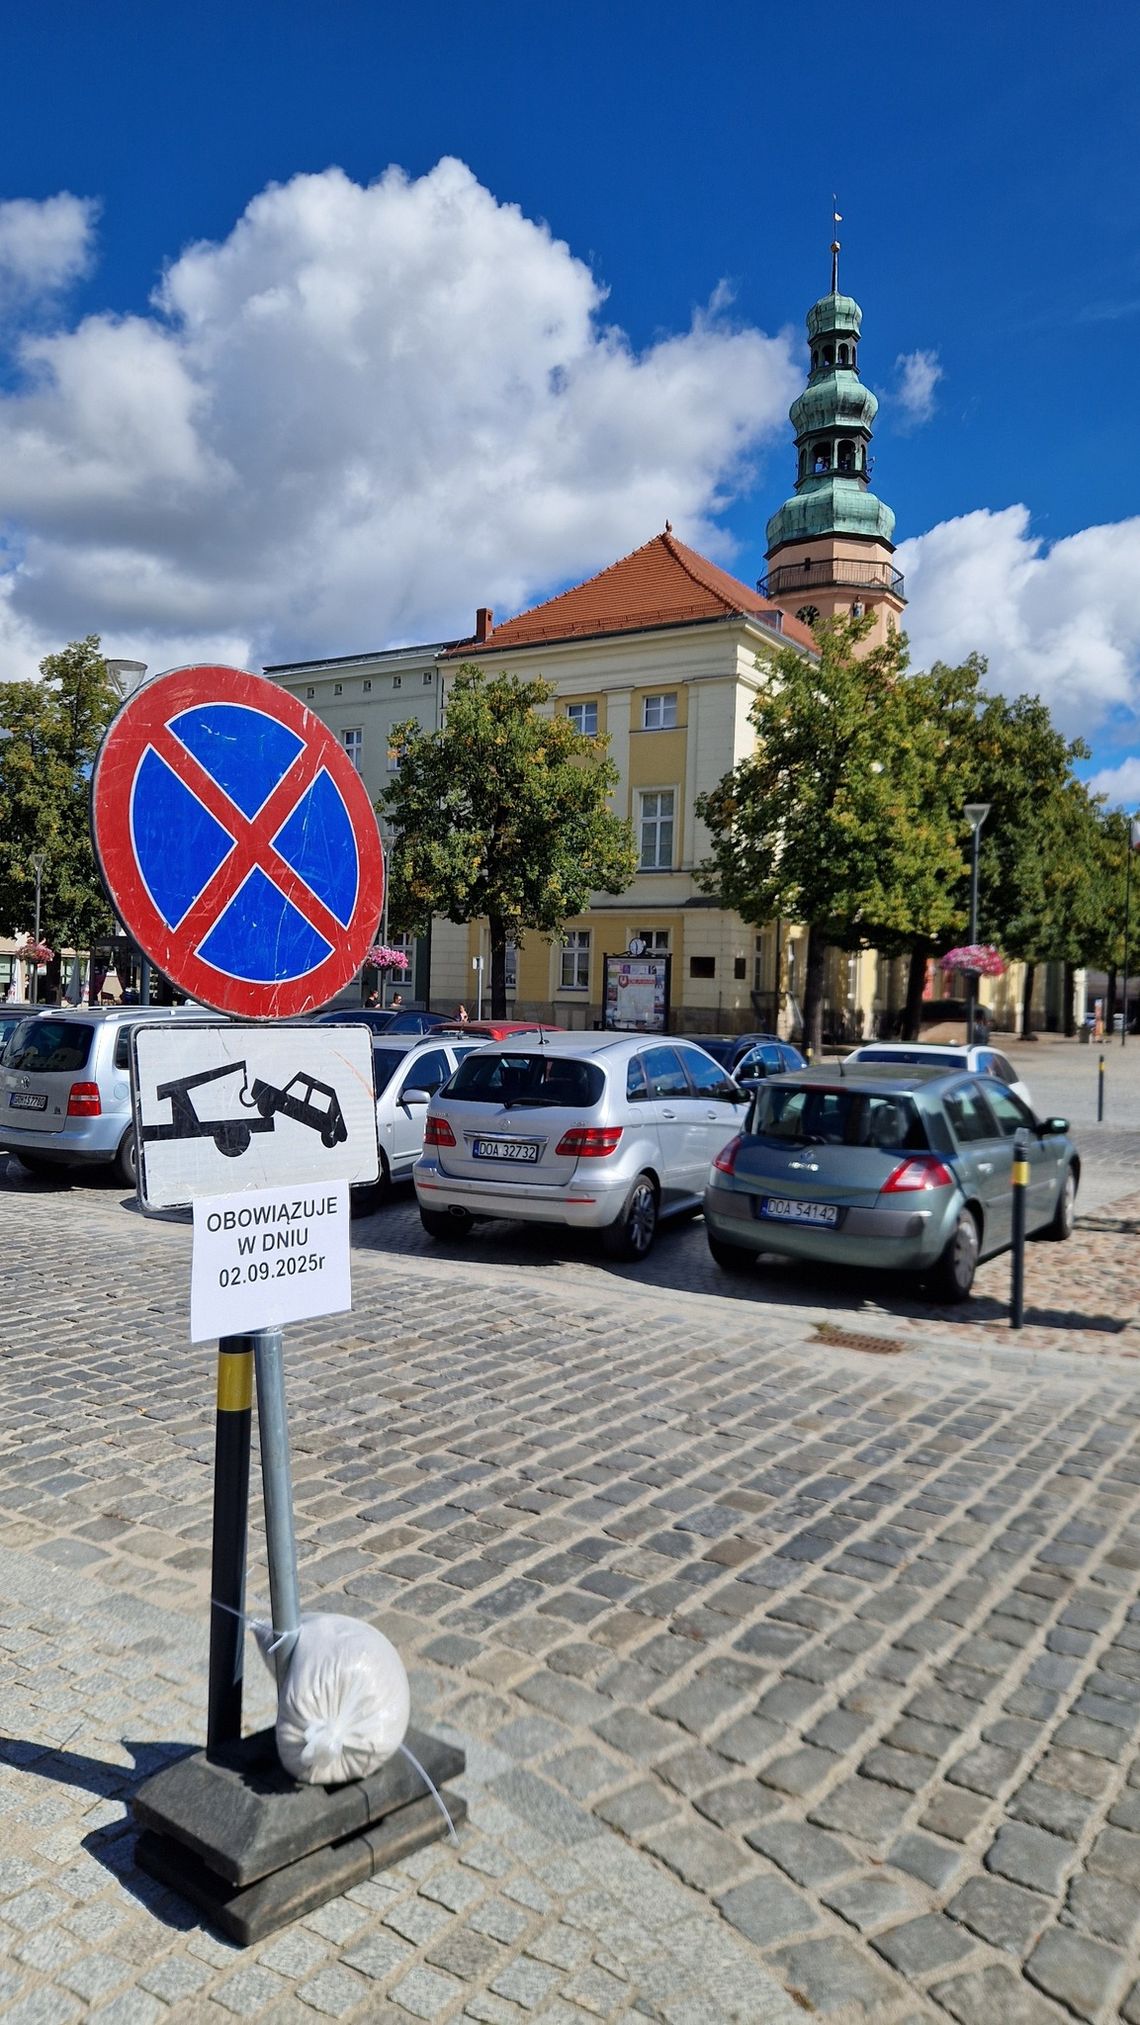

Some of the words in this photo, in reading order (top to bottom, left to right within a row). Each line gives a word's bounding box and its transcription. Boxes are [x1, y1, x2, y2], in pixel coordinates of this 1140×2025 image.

[480, 1142, 499, 1156] DOA
[503, 1145, 536, 1159] 32732
[207, 1196, 338, 1232] OBOWIĄZUJE
[768, 1200, 791, 1215] DOA
[796, 1203, 836, 1221] 54142
[238, 1235, 256, 1256] W
[262, 1227, 308, 1252] DNIU
[219, 1253, 325, 1288] 02.09.2025r
